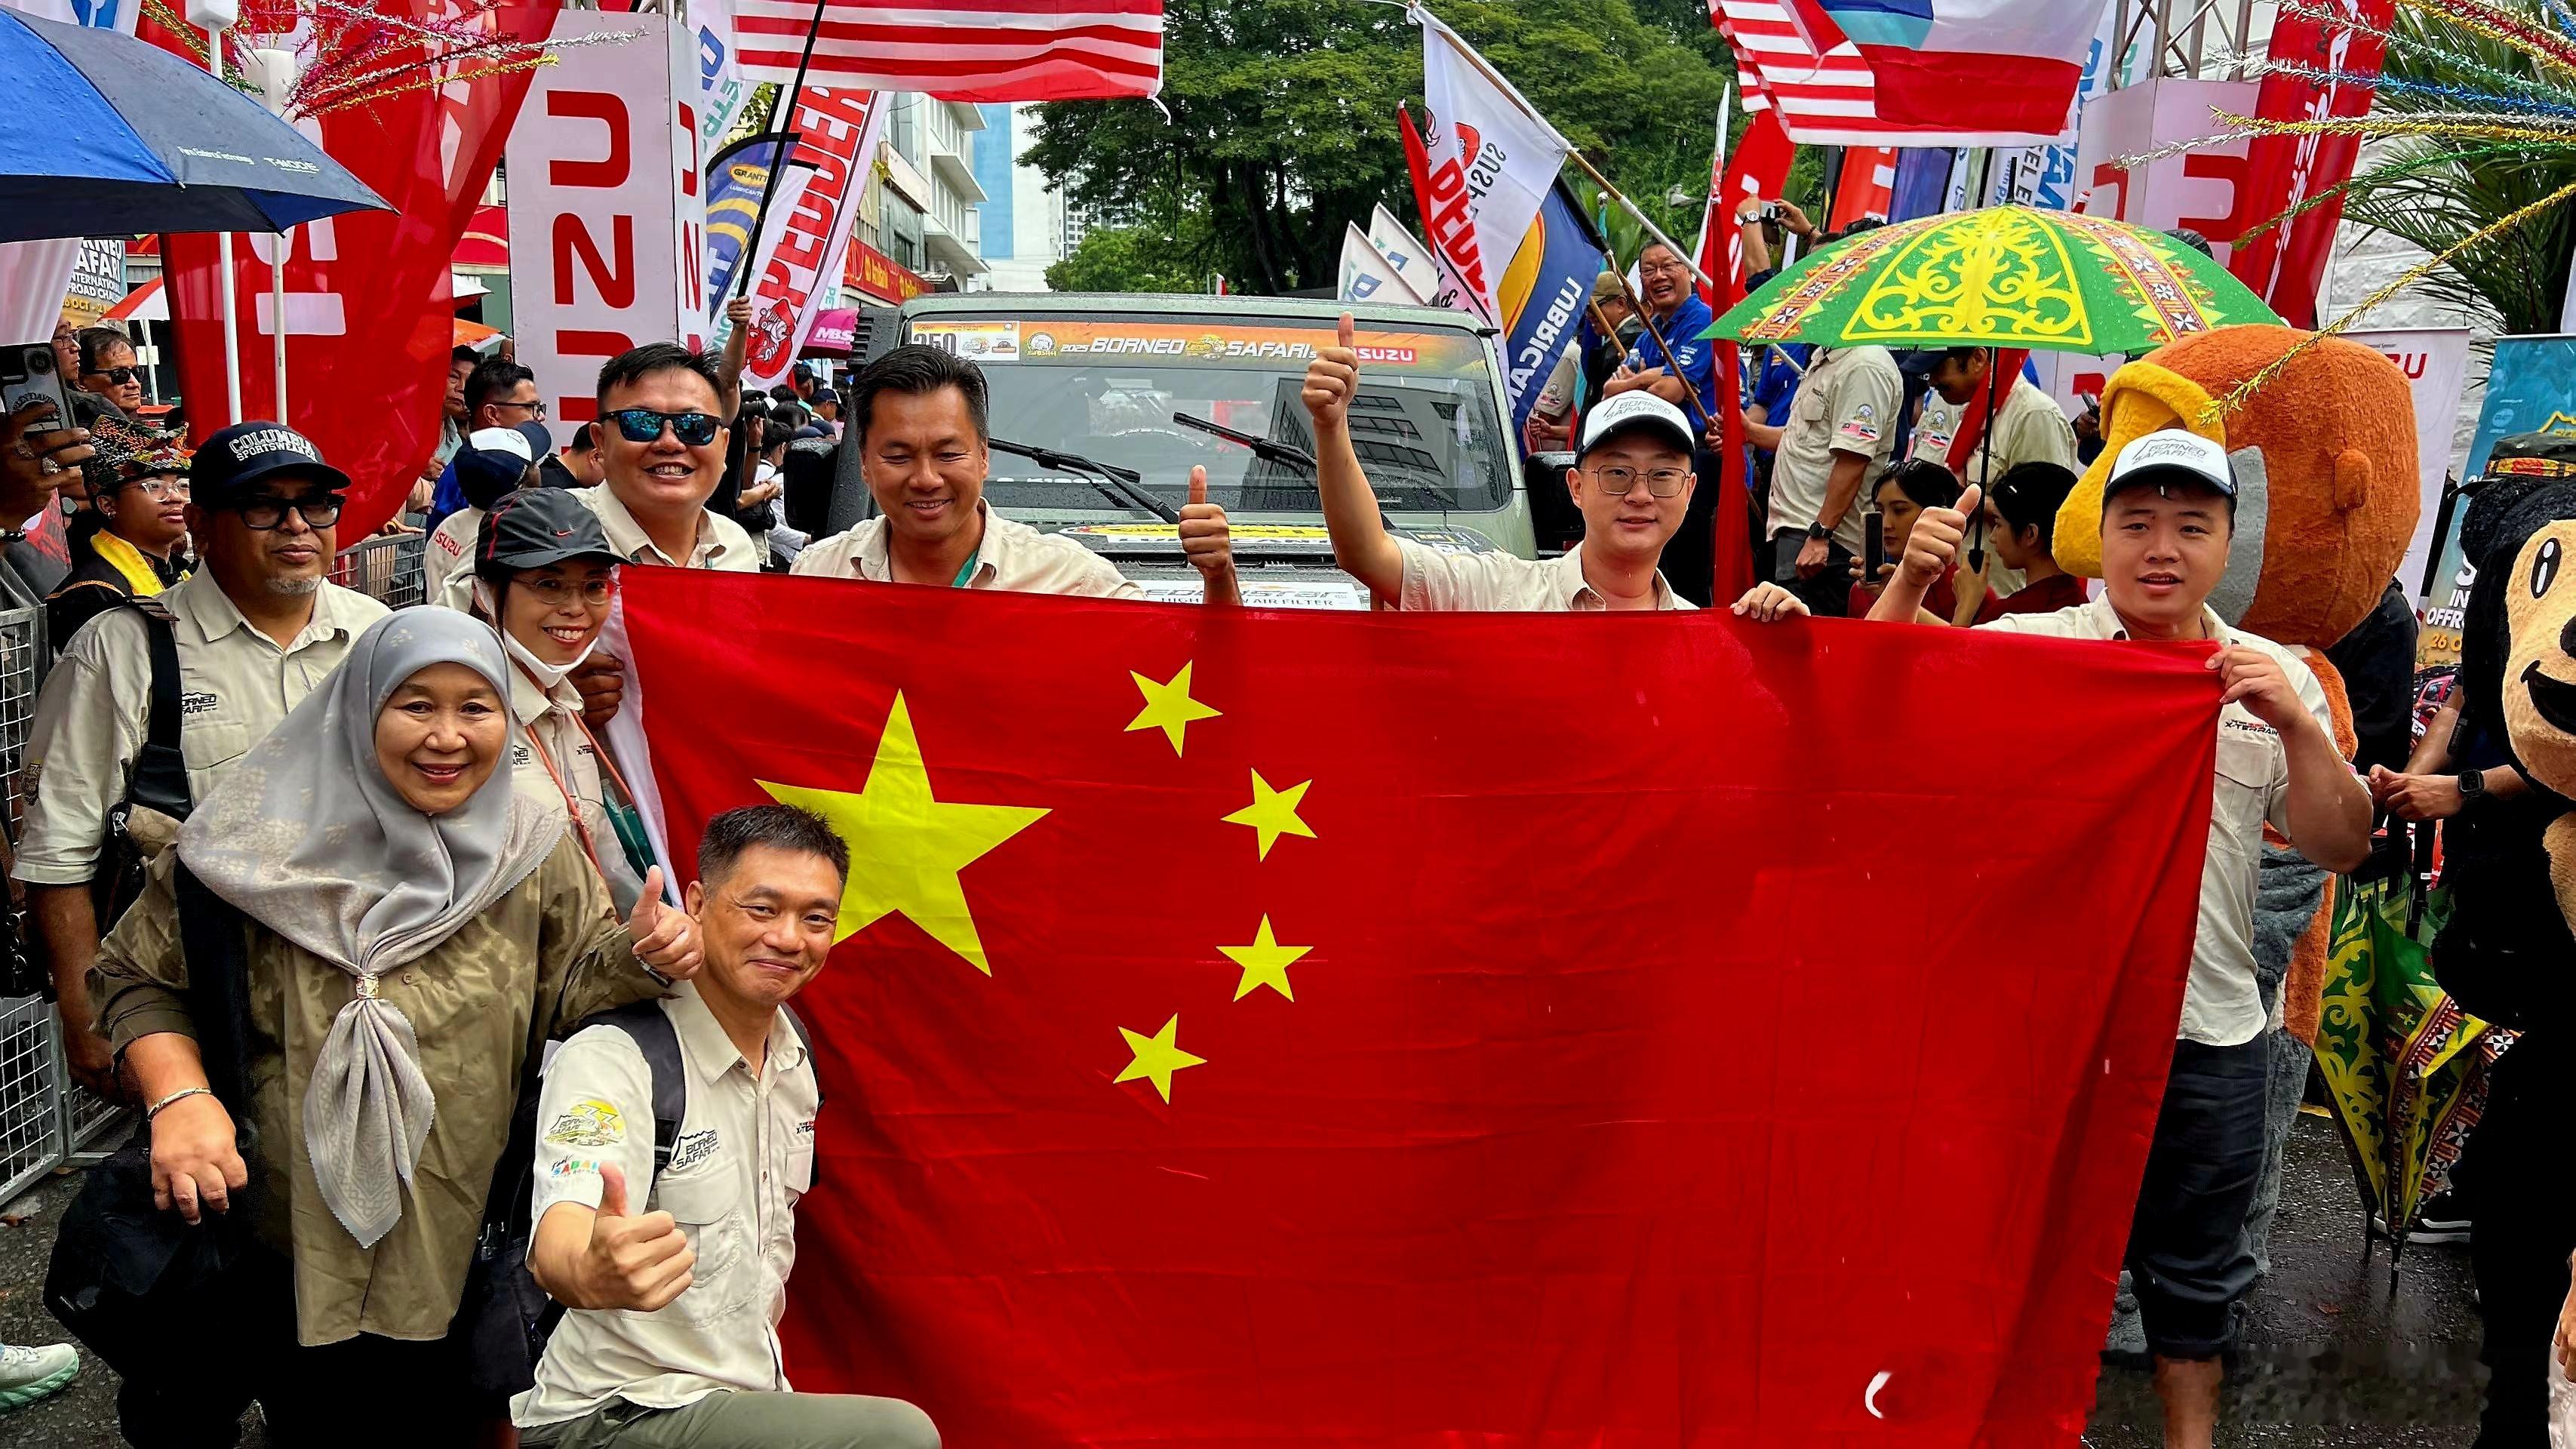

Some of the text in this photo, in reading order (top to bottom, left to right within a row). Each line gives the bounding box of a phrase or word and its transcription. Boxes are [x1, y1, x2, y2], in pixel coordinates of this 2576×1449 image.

[74, 248, 121, 283] AFARI
[1060, 344, 1090, 352] 2025
[1090, 337, 1185, 355] BORNEO
[1225, 340, 1311, 358] SAFARI
[229, 429, 313, 454] COLUMBIA
[2148, 443, 2207, 457] BORNEO
[435, 530, 462, 557] ISUZU
[2426, 607, 2464, 629] OFFR
[2430, 632, 2447, 650] 26
[686, 1132, 718, 1155] BORNEO
